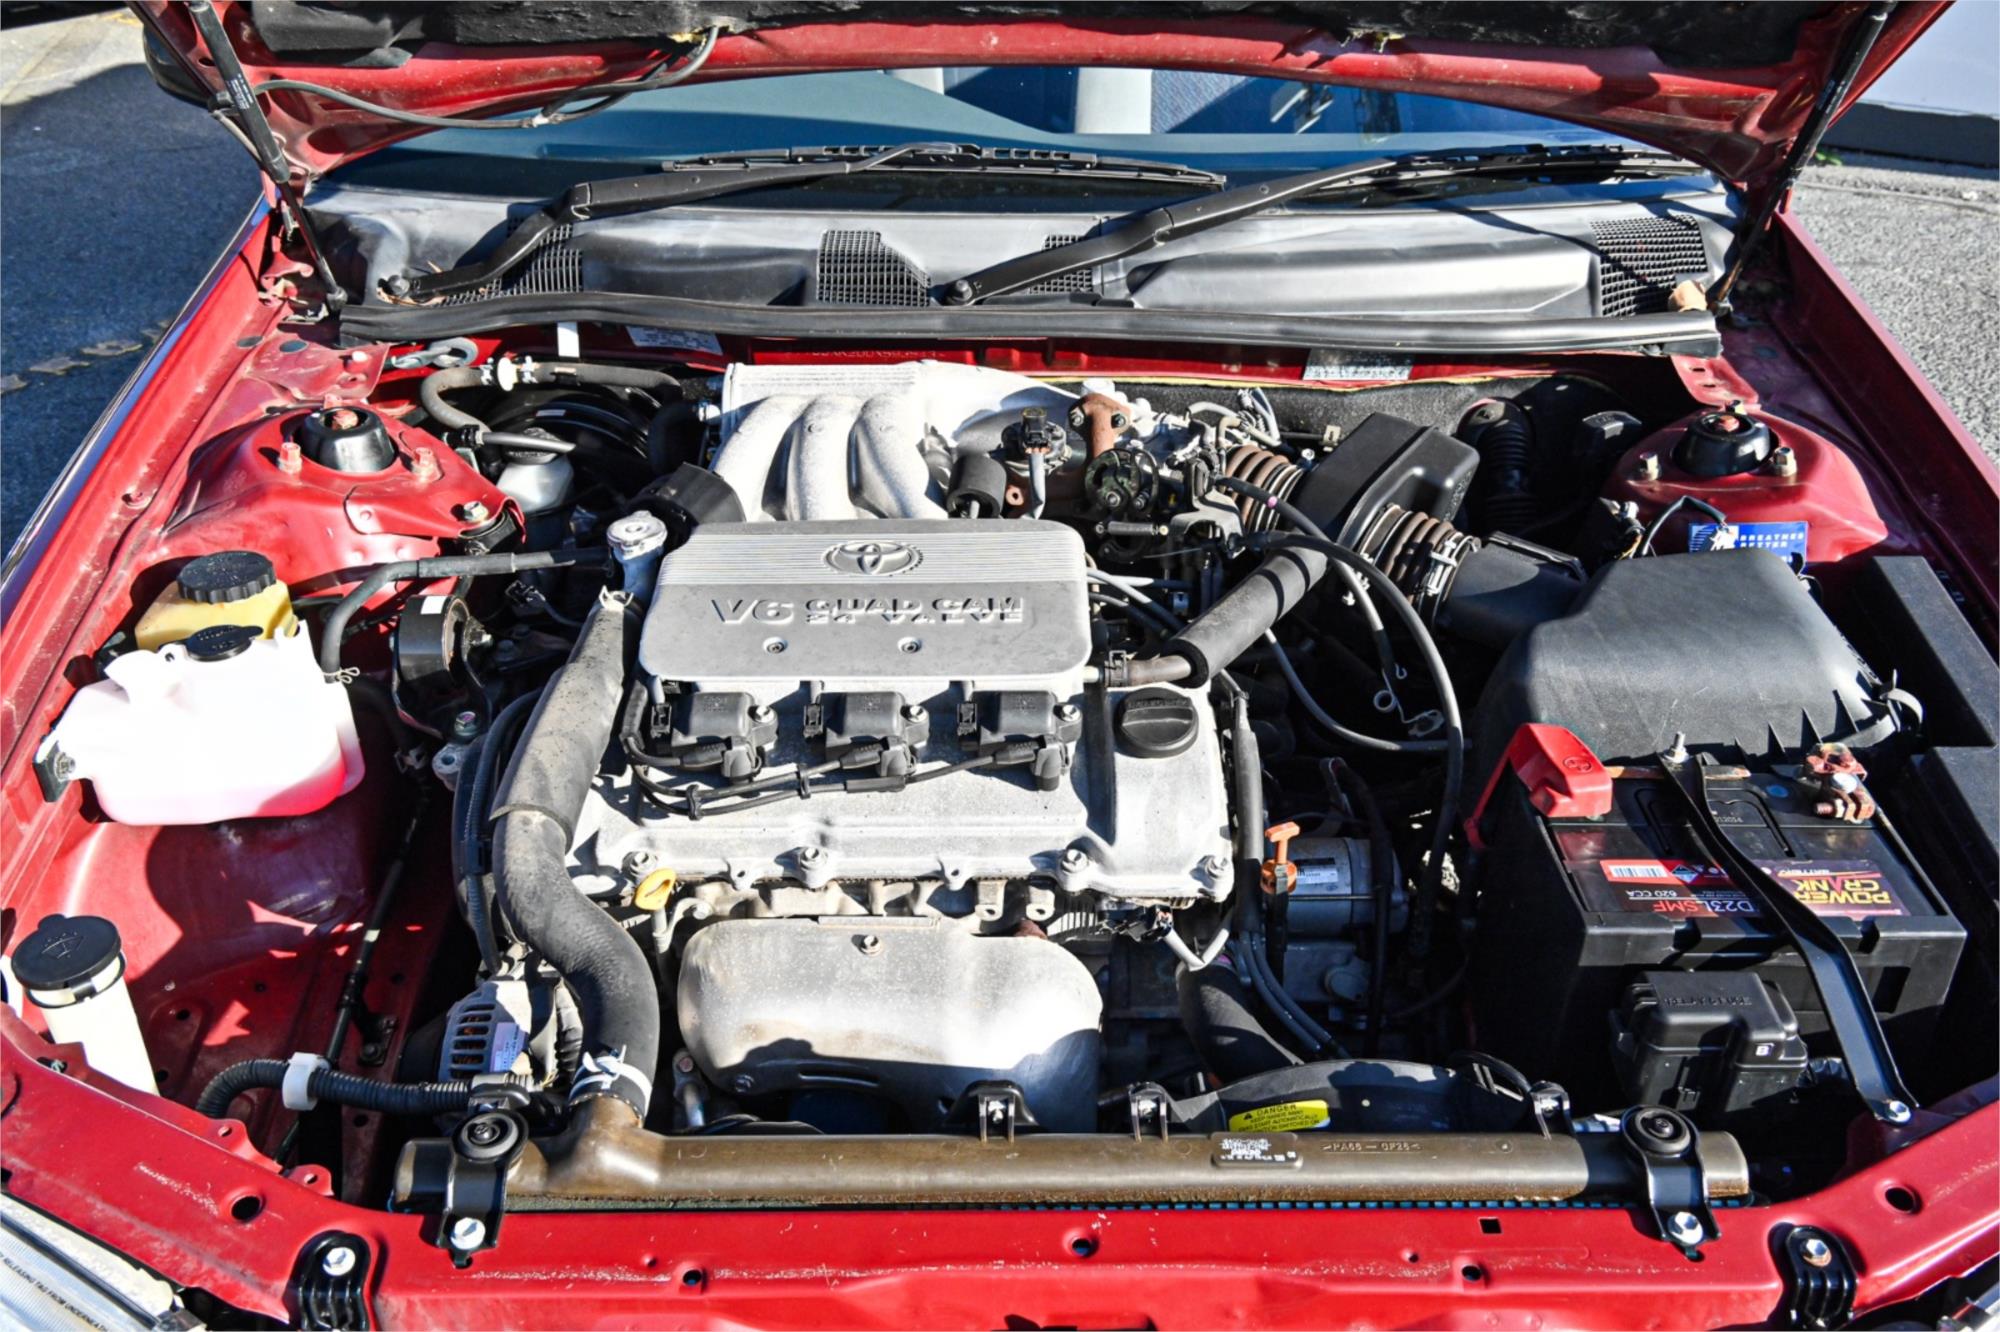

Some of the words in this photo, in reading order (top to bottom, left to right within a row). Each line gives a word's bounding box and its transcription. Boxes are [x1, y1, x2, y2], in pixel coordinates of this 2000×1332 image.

[710, 599, 795, 625] V6
[1792, 878, 1880, 892] CRANK
[1625, 889, 1652, 898] CCA
[1794, 890, 1892, 904] POWER
[1256, 1103, 1297, 1116] DANGER
